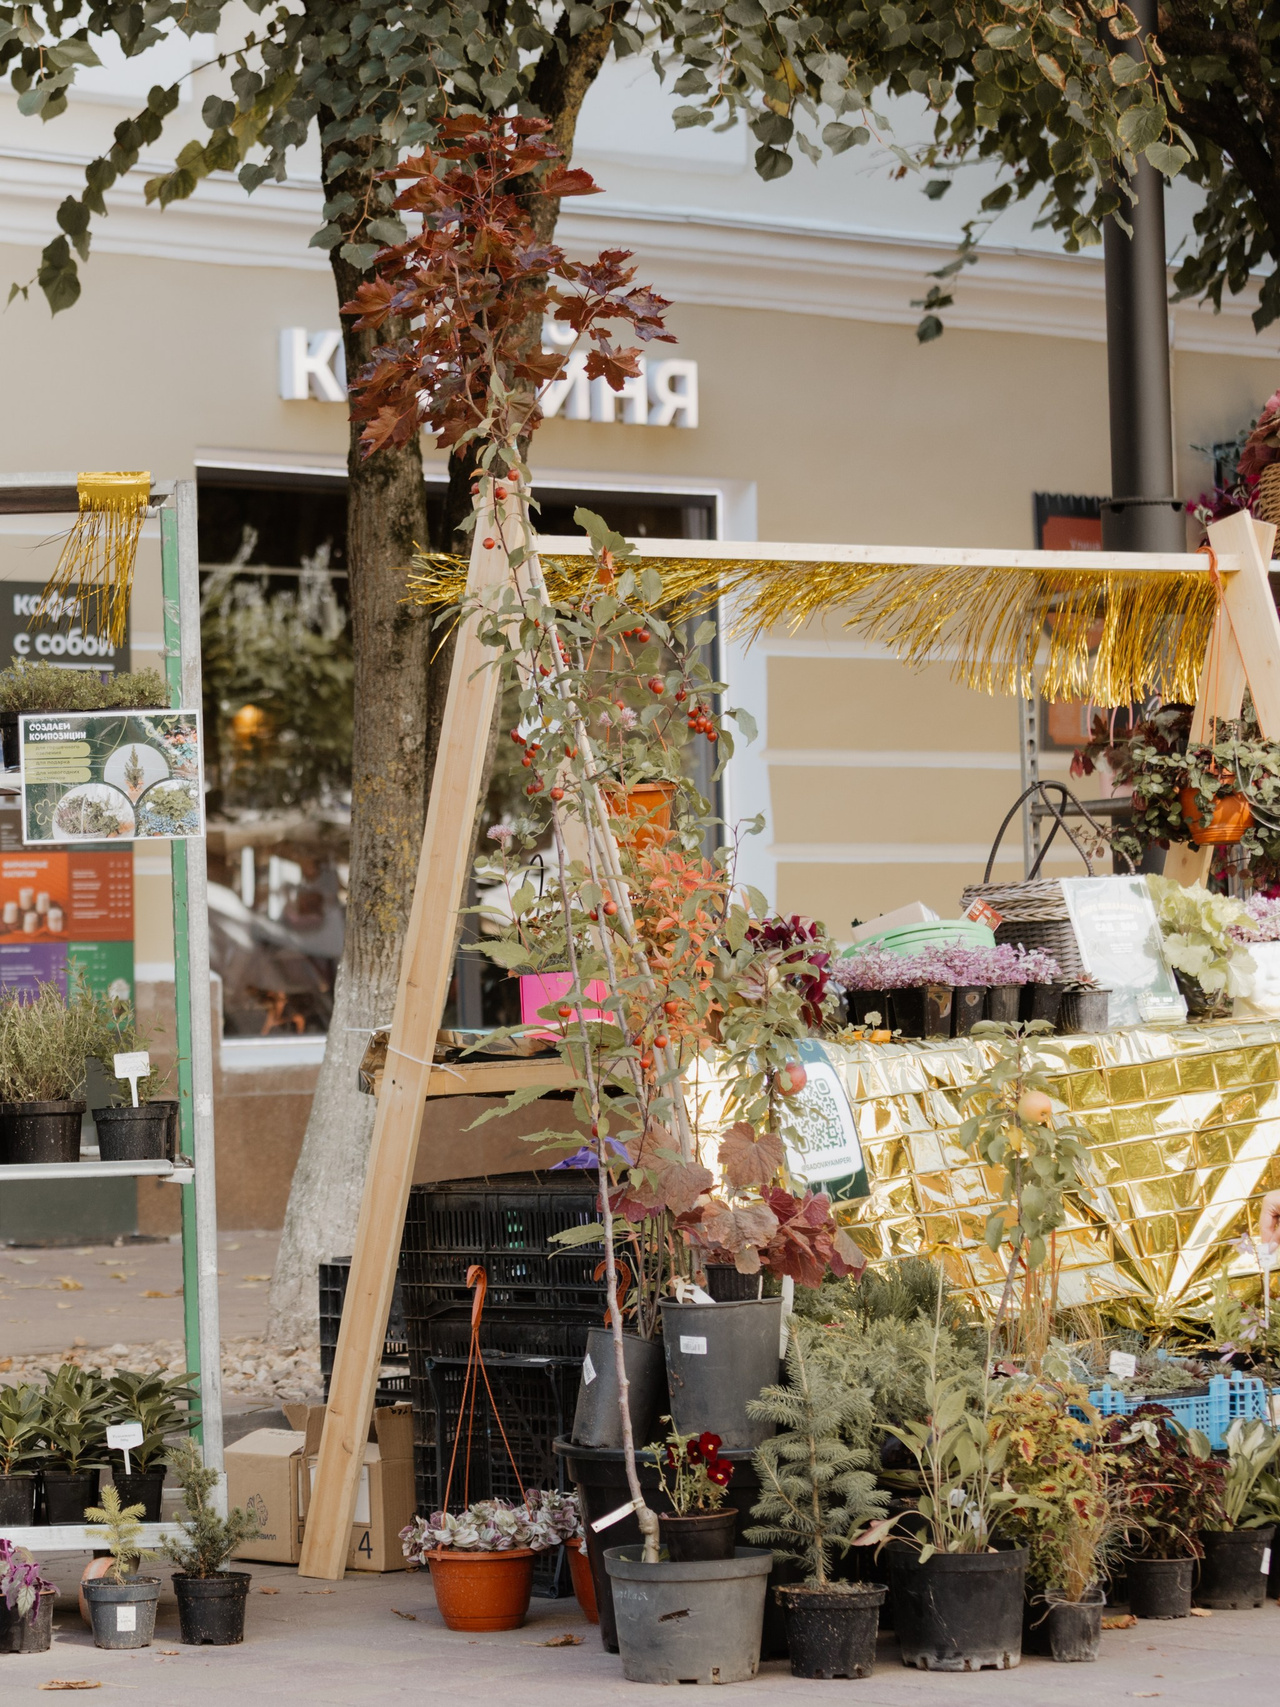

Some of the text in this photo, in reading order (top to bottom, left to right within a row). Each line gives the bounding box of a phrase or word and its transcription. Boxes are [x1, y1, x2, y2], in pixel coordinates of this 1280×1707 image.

[279, 318, 699, 428] КЙНЯ
[13, 589, 81, 623] кофе
[13, 627, 116, 657] с собой
[29, 723, 71, 732] СОЗДАЕМ
[29, 732, 87, 741] КОМПОЗИЦИИ
[358, 1530, 373, 1560] 4
